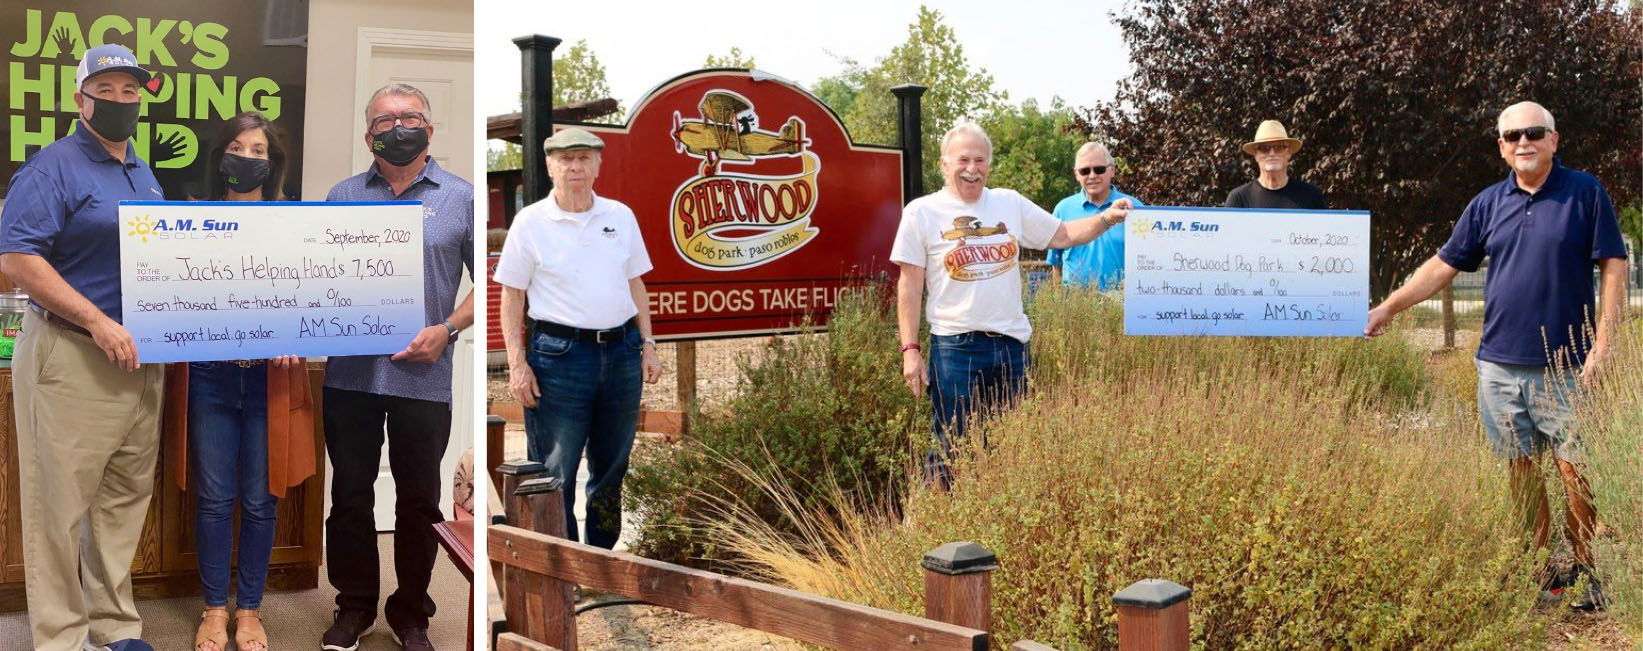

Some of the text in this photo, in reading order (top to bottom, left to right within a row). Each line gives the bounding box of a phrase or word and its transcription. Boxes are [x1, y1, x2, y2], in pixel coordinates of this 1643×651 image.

[10, 62, 281, 121] HPING
[678, 179, 811, 239] SHERWOOD
[153, 219, 239, 231] A.M. Sun
[1151, 220, 1219, 232] A.M. Sun
[159, 232, 233, 240] SOLAR
[383, 228, 411, 243] 2020
[1325, 233, 1349, 246] 2020
[695, 241, 716, 259] dog
[718, 246, 744, 259] park
[749, 243, 773, 258] paso
[175, 256, 234, 282] Jack's
[241, 253, 301, 289] Helping
[351, 258, 394, 280] 7,500
[1173, 252, 1284, 278] Sherwood Dog Park
[1310, 255, 1354, 276] 2,000
[1136, 279, 1203, 296] two-thousand
[1214, 282, 1246, 296] dollars
[173, 294, 218, 311] thousand
[227, 293, 298, 309] five-hundred
[308, 299, 321, 308] and
[647, 291, 687, 315] ERE
[693, 289, 754, 313] DOGS
[759, 287, 808, 310] TAKE
[1155, 307, 1188, 323] support
[1211, 311, 1221, 326] go
[1264, 302, 1287, 321] AM
[1289, 303, 1313, 321] Sun
[330, 316, 357, 336] Sun
[362, 314, 396, 336] Solar
[164, 326, 204, 347] support
[234, 329, 246, 347] go
